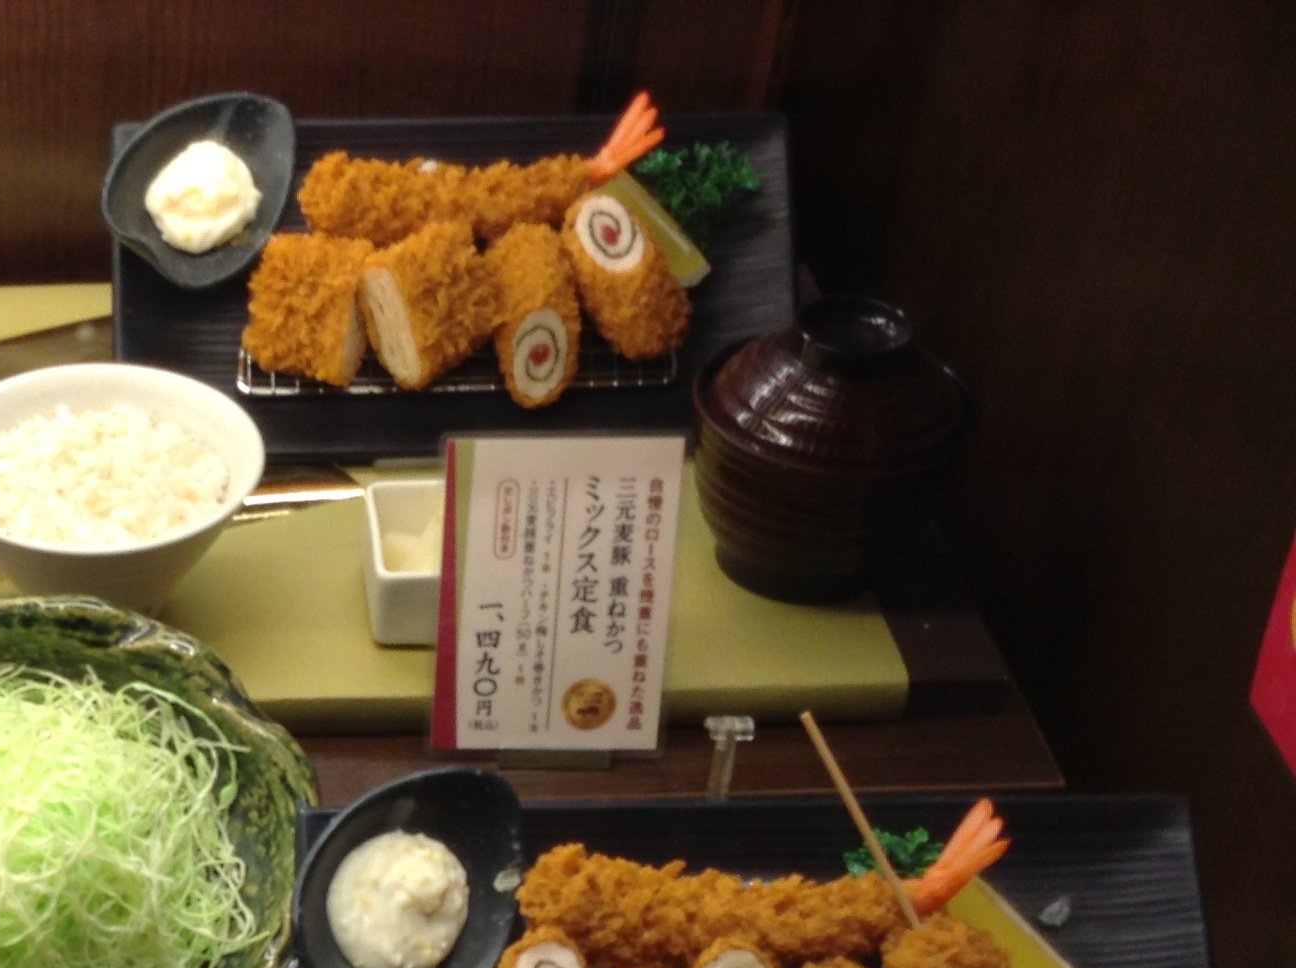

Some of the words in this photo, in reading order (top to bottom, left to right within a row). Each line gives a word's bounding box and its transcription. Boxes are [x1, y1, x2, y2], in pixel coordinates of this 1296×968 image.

[569, 475, 605, 636] ミックス定食
[603, 576, 629, 656] 重ねかつ
